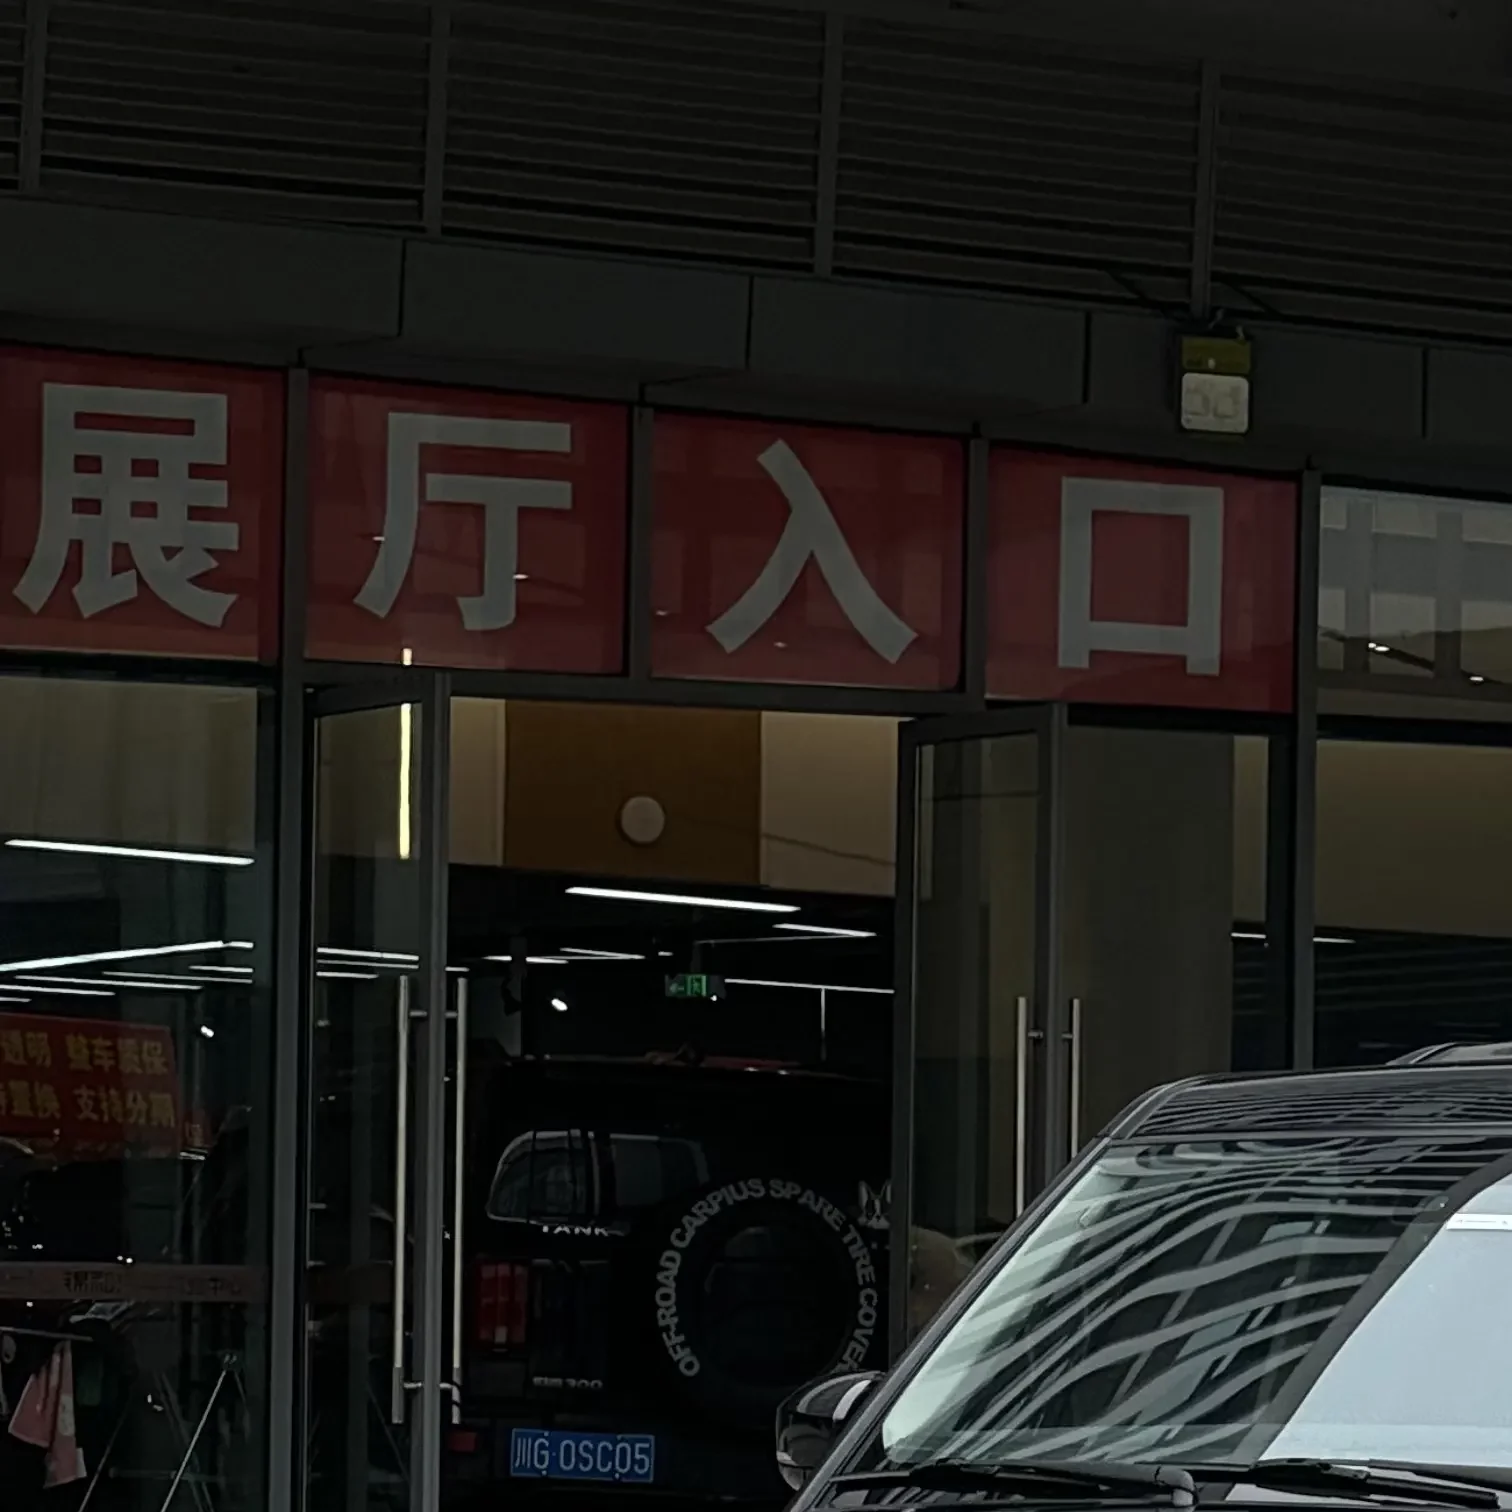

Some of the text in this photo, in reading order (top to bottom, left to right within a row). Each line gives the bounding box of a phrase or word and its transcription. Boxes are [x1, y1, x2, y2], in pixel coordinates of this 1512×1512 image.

[12, 382, 1225, 677] 展厅入口
[654, 1249, 701, 1378] OFF-ROAD
[768, 1177, 847, 1232] SPARE
[840, 1223, 877, 1287] TIRE
